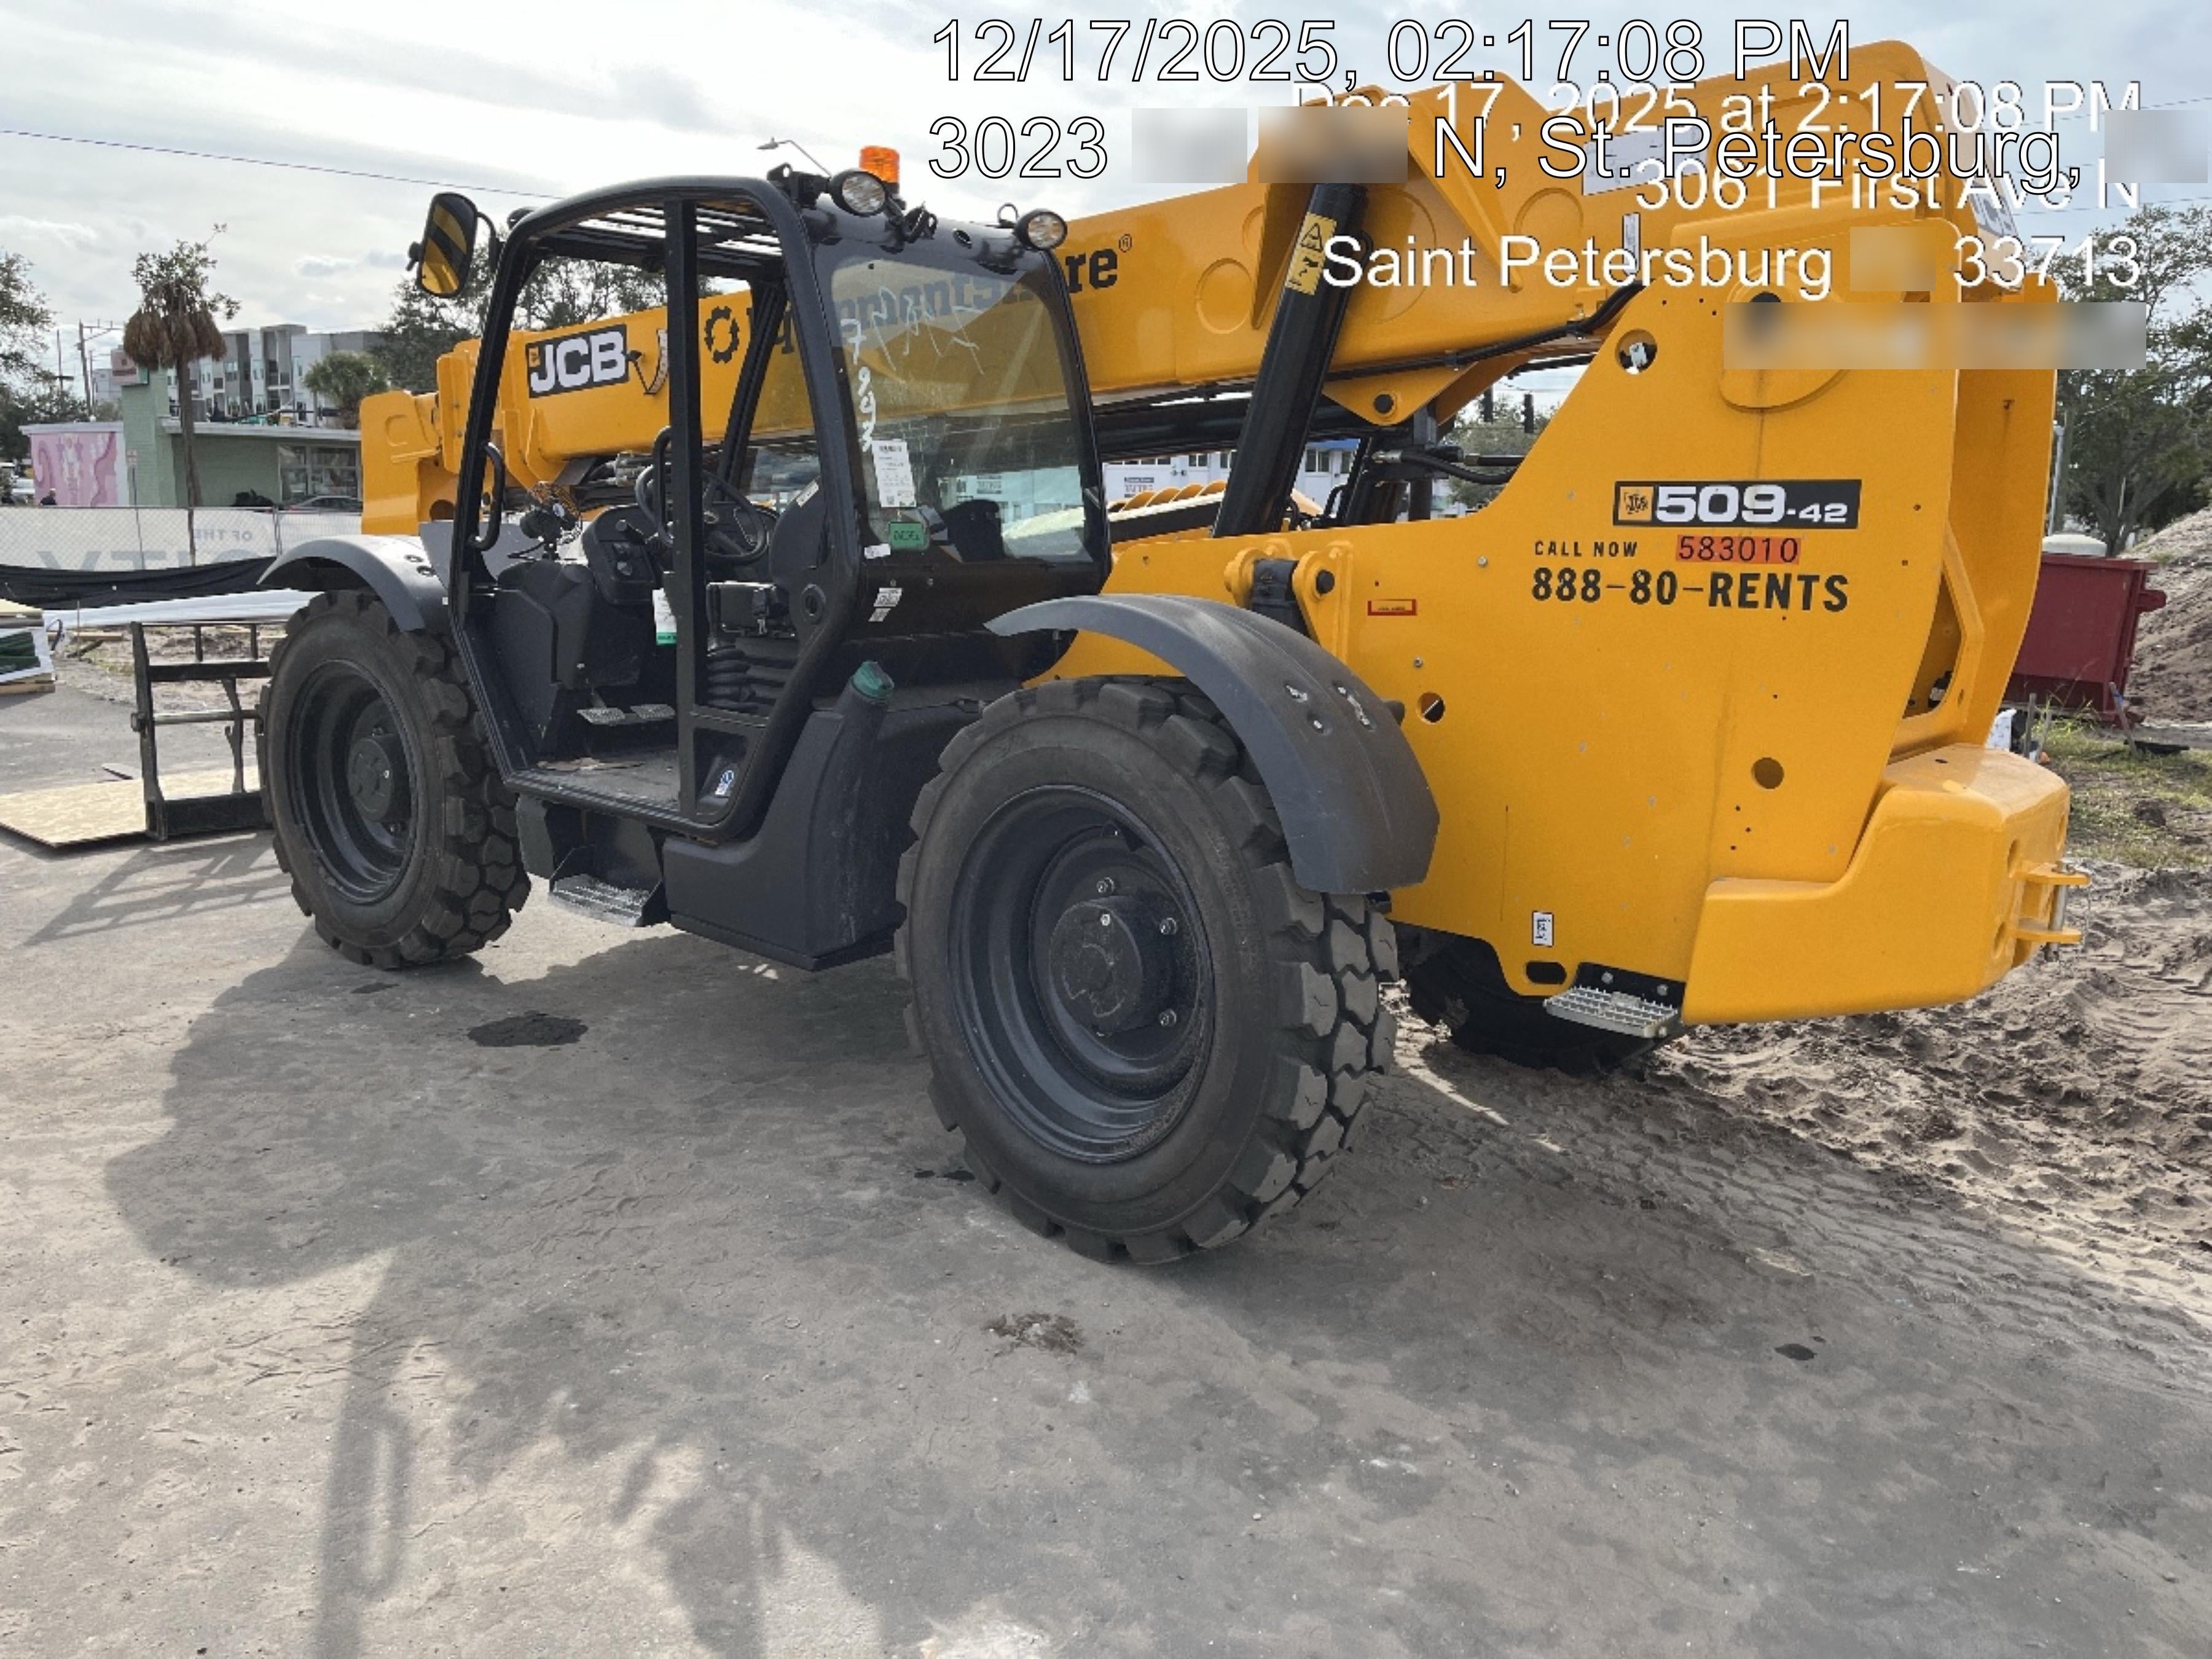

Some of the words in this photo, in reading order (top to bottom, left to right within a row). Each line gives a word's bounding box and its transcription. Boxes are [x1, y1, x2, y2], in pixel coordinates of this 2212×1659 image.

[530, 331, 626, 393] JCB
[1534, 540, 1582, 557] CALL
[1593, 541, 1638, 557] NOW
[1679, 536, 1799, 563] 583010
[1532, 567, 1849, 612] 888-80-RENTS
